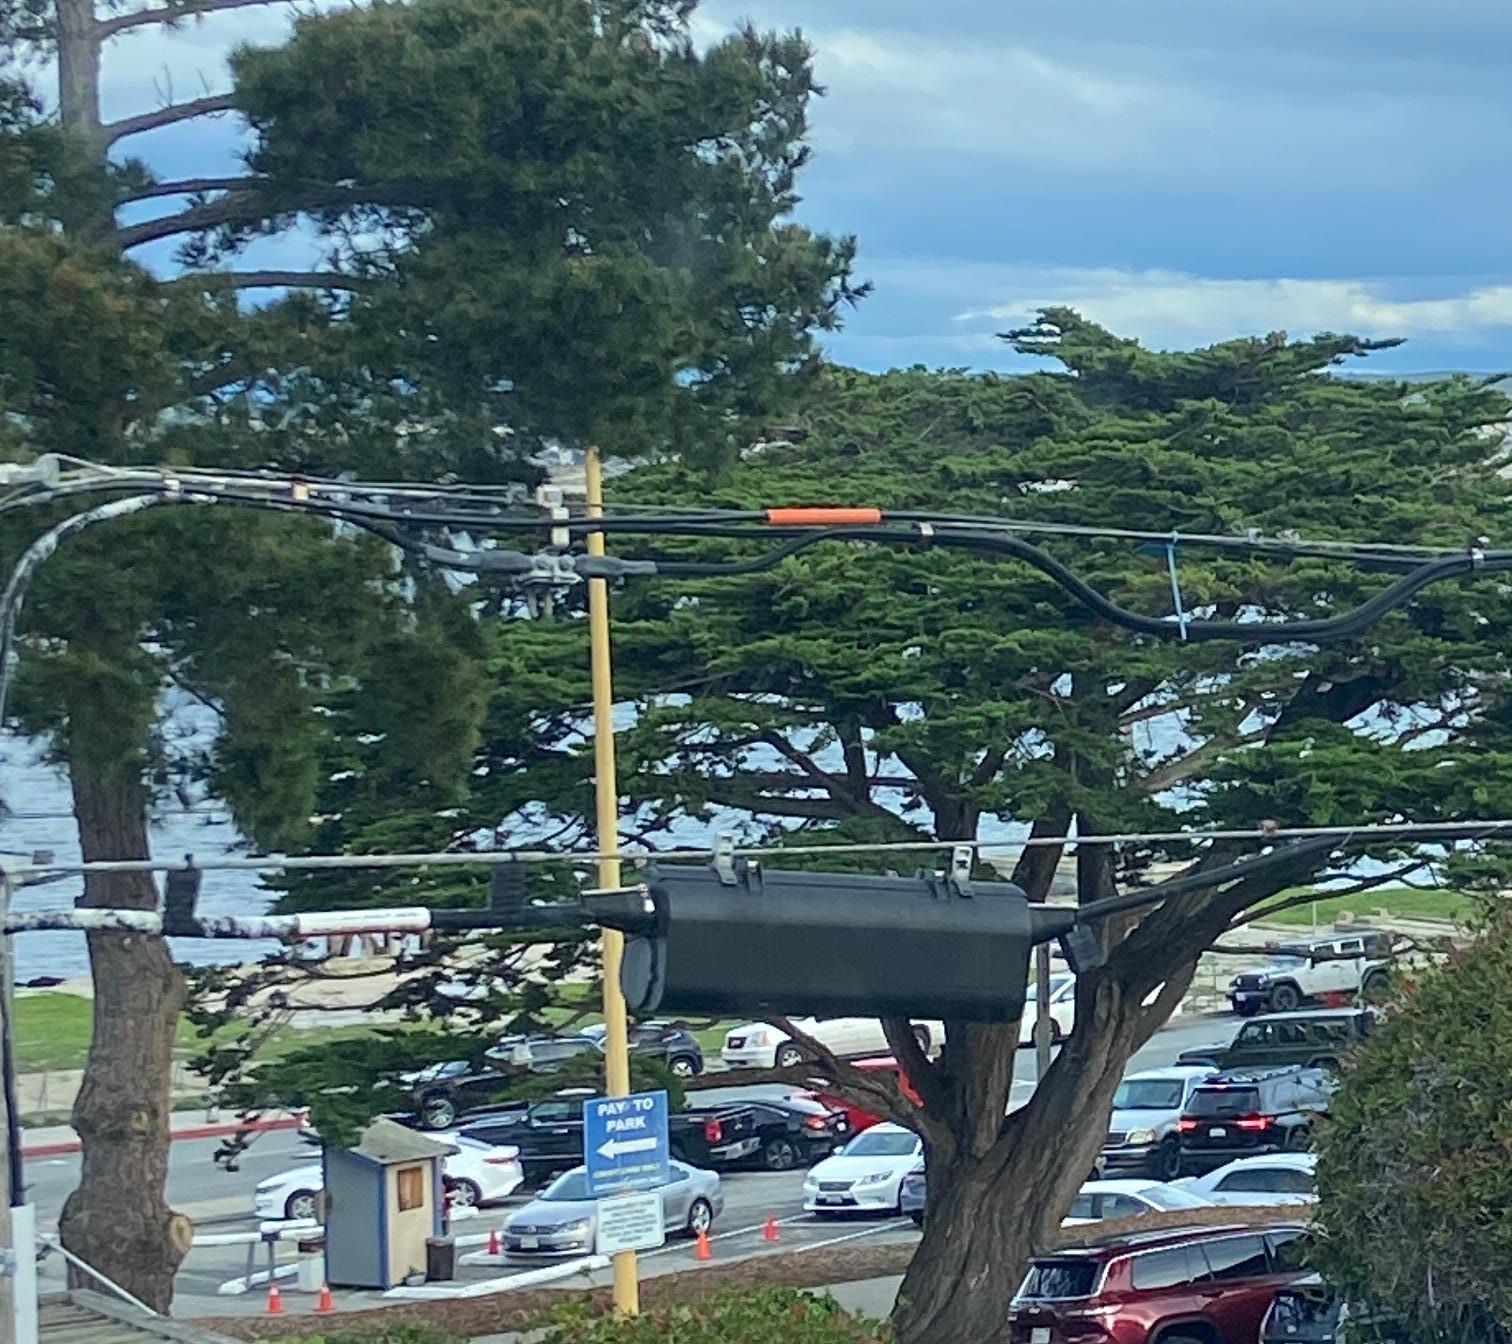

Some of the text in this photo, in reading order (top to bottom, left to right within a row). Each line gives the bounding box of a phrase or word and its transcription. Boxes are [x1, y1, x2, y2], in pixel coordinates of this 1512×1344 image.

[597, 1098, 654, 1116] PAY TO
[606, 1116, 646, 1133] PARK
